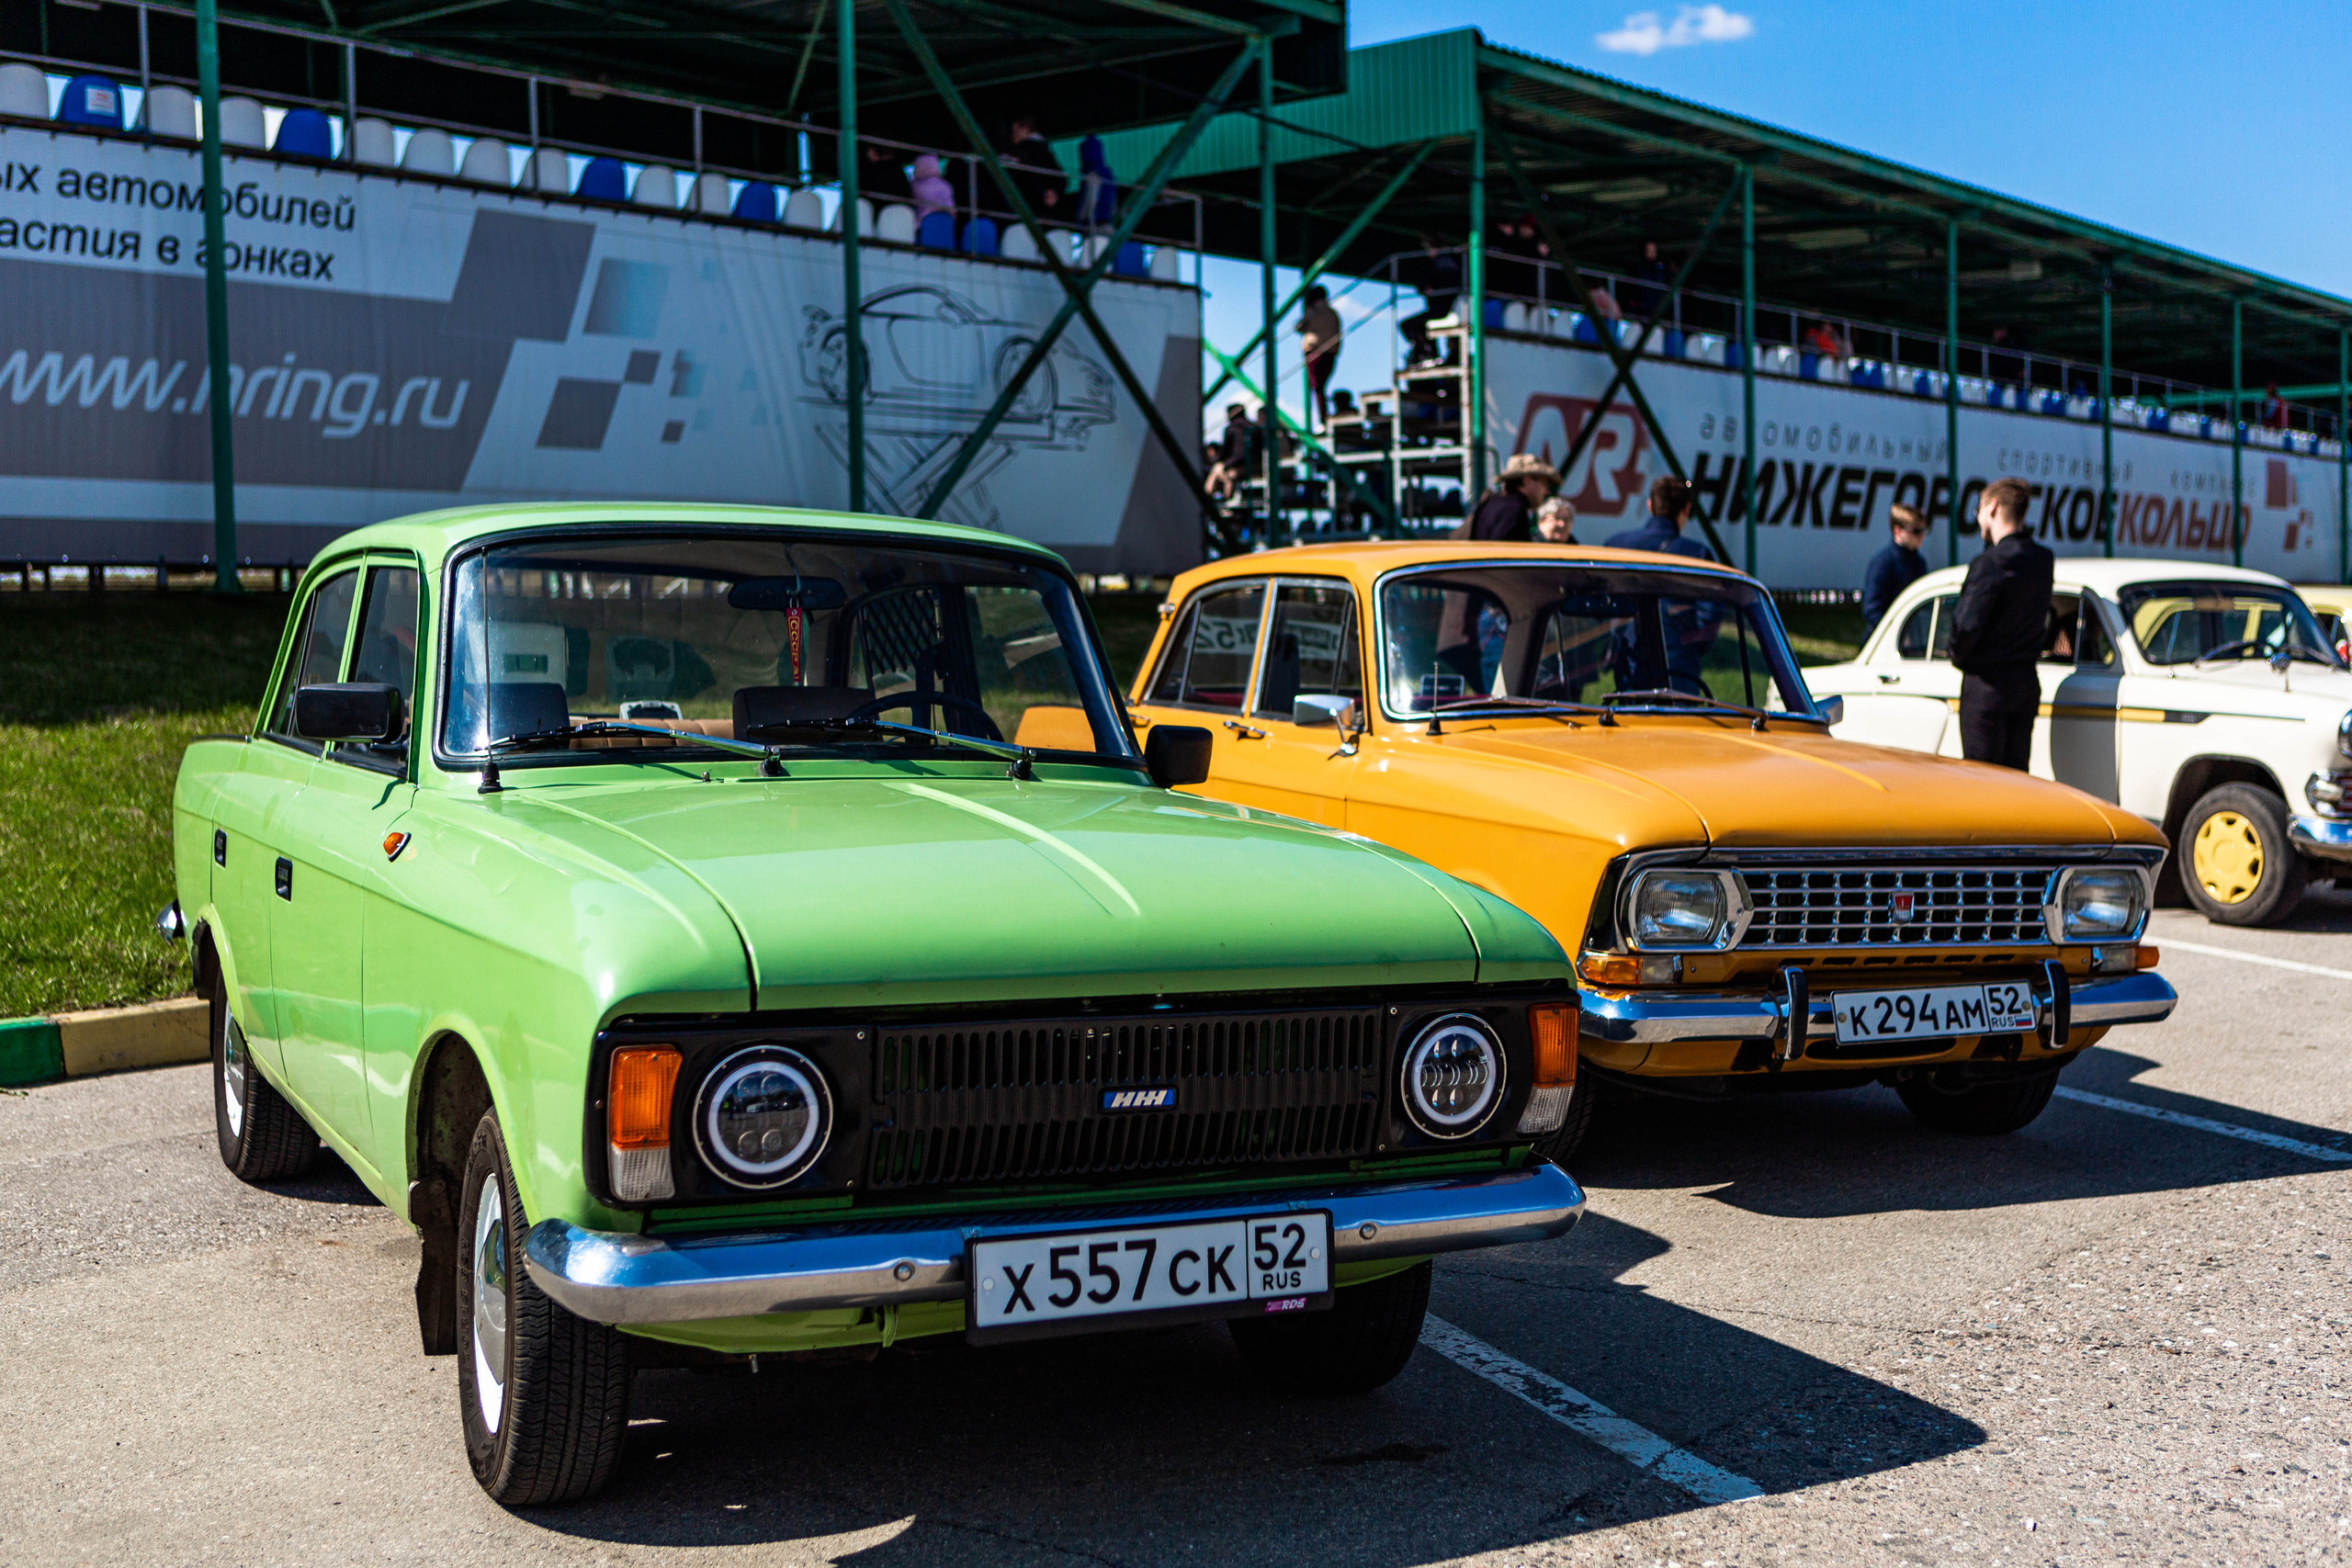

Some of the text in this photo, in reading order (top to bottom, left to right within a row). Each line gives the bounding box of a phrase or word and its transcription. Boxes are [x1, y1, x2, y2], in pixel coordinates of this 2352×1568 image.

[157, 235, 180, 265] в
[1700, 412, 1948, 463] авомобильный
[1988, 986, 2022, 1015] 52
[1991, 1015, 2015, 1029] RUS
[1254, 1224, 1306, 1271] 52
[1262, 1271, 1302, 1292] RUS
